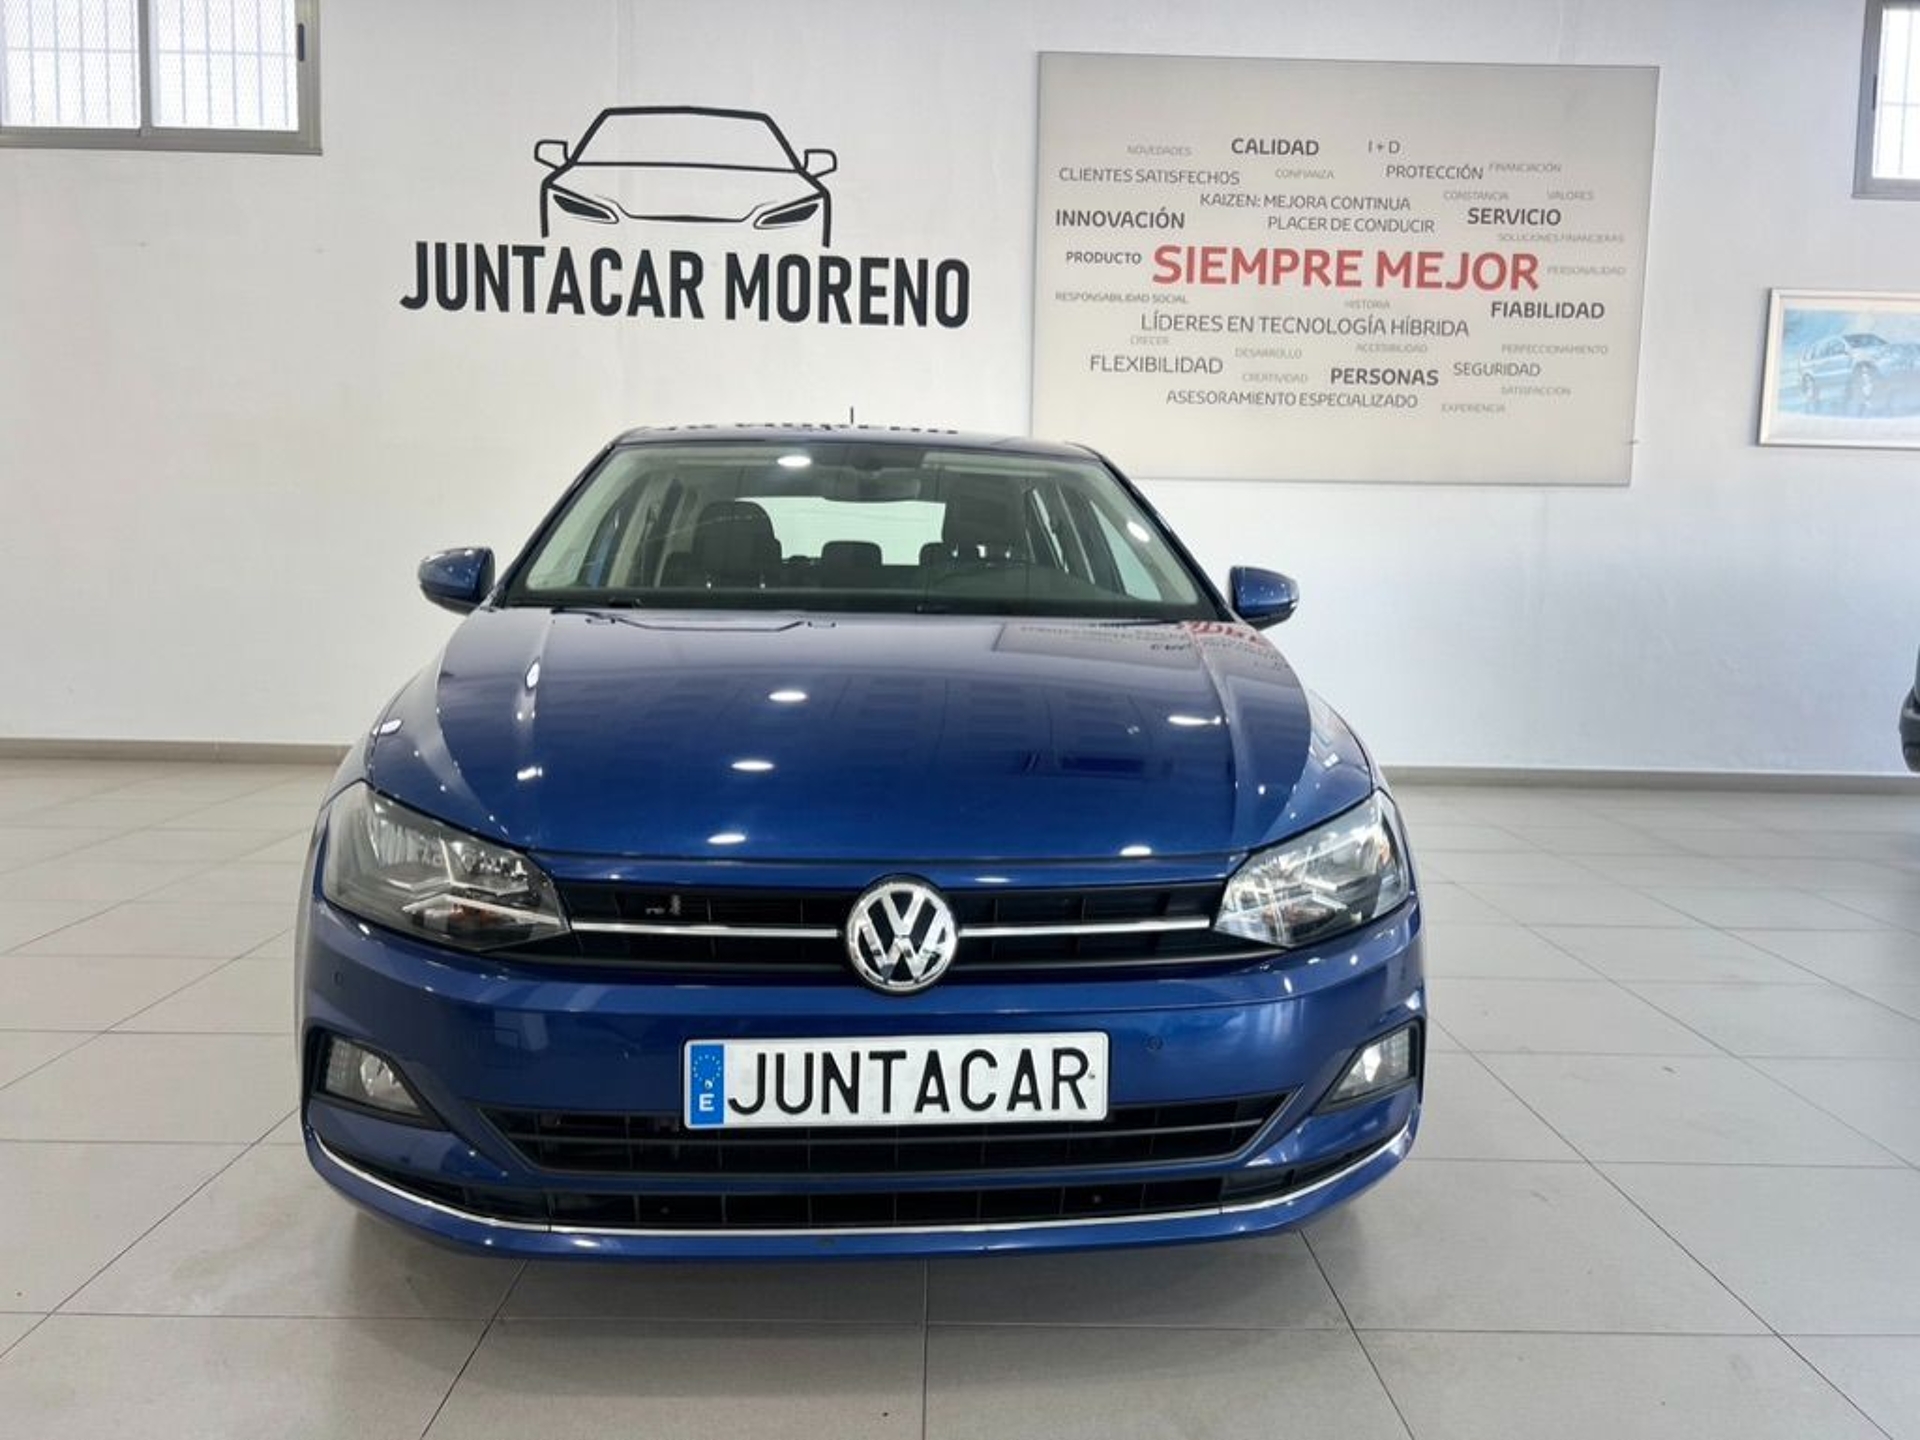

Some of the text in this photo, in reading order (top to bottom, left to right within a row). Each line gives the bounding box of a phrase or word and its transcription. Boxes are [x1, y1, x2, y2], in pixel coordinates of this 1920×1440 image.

[1231, 138, 1319, 156] CALIDAD
[1058, 167, 1240, 185] CLIENTES SATISFECHOS
[1386, 163, 1483, 180] PROTECCIÓN
[1263, 195, 1328, 209] MEJORA
[1331, 196, 1410, 211] CONTINUA
[1056, 207, 1185, 229] INNOVACIÓN
[1268, 216, 1434, 233] PLACER DE CONDUCIR
[1467, 207, 1562, 226] SERVICIO
[1066, 251, 1141, 265] PRODUCTO
[1152, 244, 1539, 291] SIEMPRE MEJOR
[400, 240, 970, 328] JUNTACAR MORENO
[1055, 291, 1187, 304] RESPONSABILIDAD SOCIAL
[1490, 301, 1605, 320] FIABILIDAD
[1141, 310, 1470, 338] LÍDERES EN TECNOLOGÍA HÍBRIDA
[1090, 354, 1224, 374] FLEXIBILIDAD
[1453, 361, 1541, 378] SEGURIDAD
[1331, 367, 1439, 386] PERSONAS
[1166, 390, 1418, 409] ASESORAMIENTO ESPECIALIZADO
[699, 1048, 1090, 1116] E JUNTACAR
